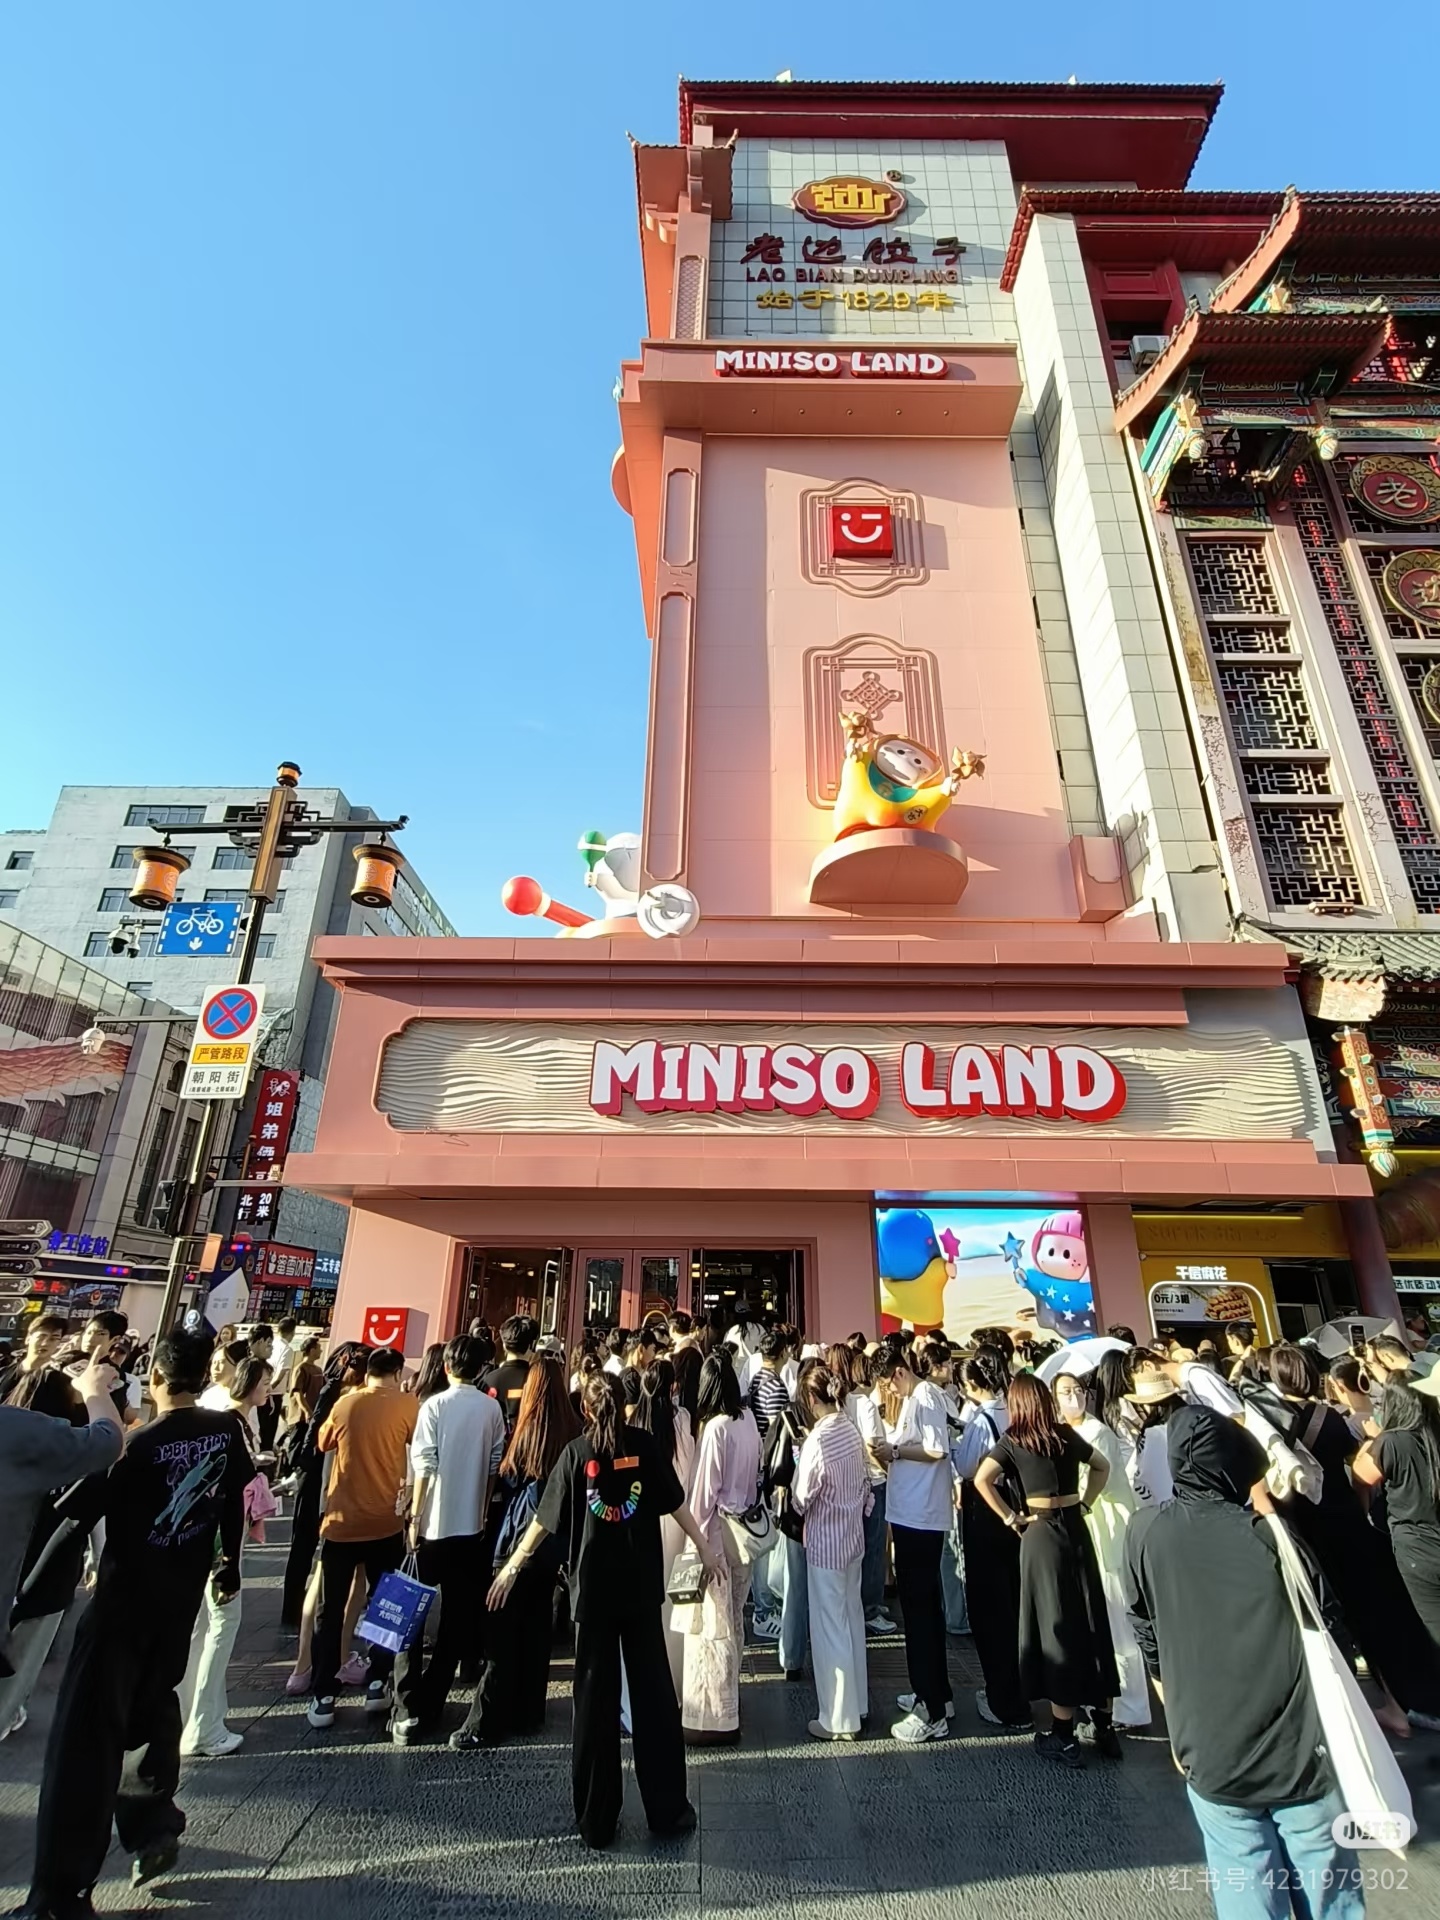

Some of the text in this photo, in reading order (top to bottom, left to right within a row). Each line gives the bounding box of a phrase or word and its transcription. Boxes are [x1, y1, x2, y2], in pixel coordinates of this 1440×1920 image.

[746, 267, 958, 284] LAO BIAN DUMPLING
[756, 289, 956, 311] 始于1829年
[715, 350, 948, 379] MINISO LAND
[197, 1047, 245, 1060] 严管路段
[192, 1071, 240, 1083] 朝阳街
[590, 1040, 1126, 1121] MINISO LAND
[275, 1254, 314, 1278] 蜜雪冰城
[1175, 1266, 1228, 1280] 千层麻花
[1393, 1279, 1440, 1290] 选优质动
[586, 1480, 642, 1522] MINISO LAND
